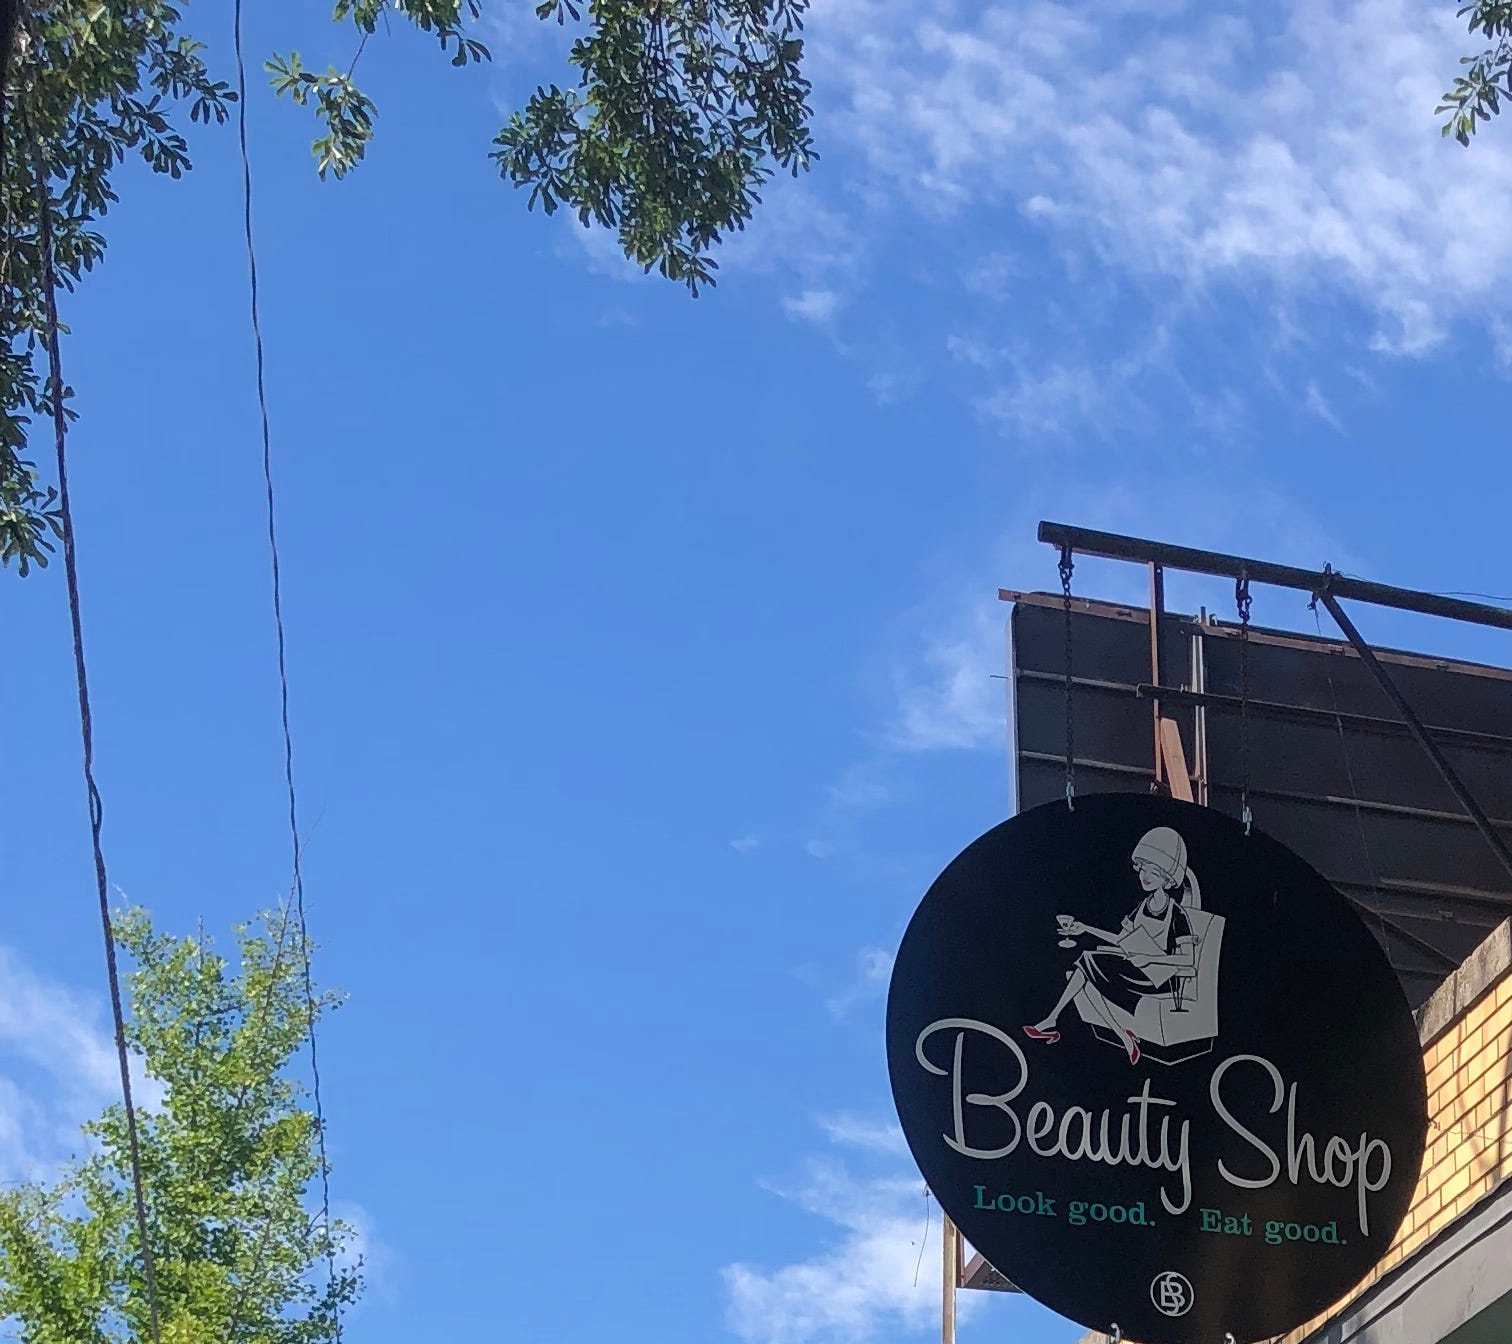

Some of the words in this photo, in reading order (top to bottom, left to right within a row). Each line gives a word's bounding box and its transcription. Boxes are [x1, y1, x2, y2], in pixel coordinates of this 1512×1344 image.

[915, 1018, 1192, 1215] Beauty
[1210, 1055, 1392, 1236] Shop
[974, 1185, 1056, 1217] Look
[1068, 1202, 1156, 1227] good.
[1201, 1209, 1253, 1237] Eat
[1265, 1219, 1347, 1247] good.
